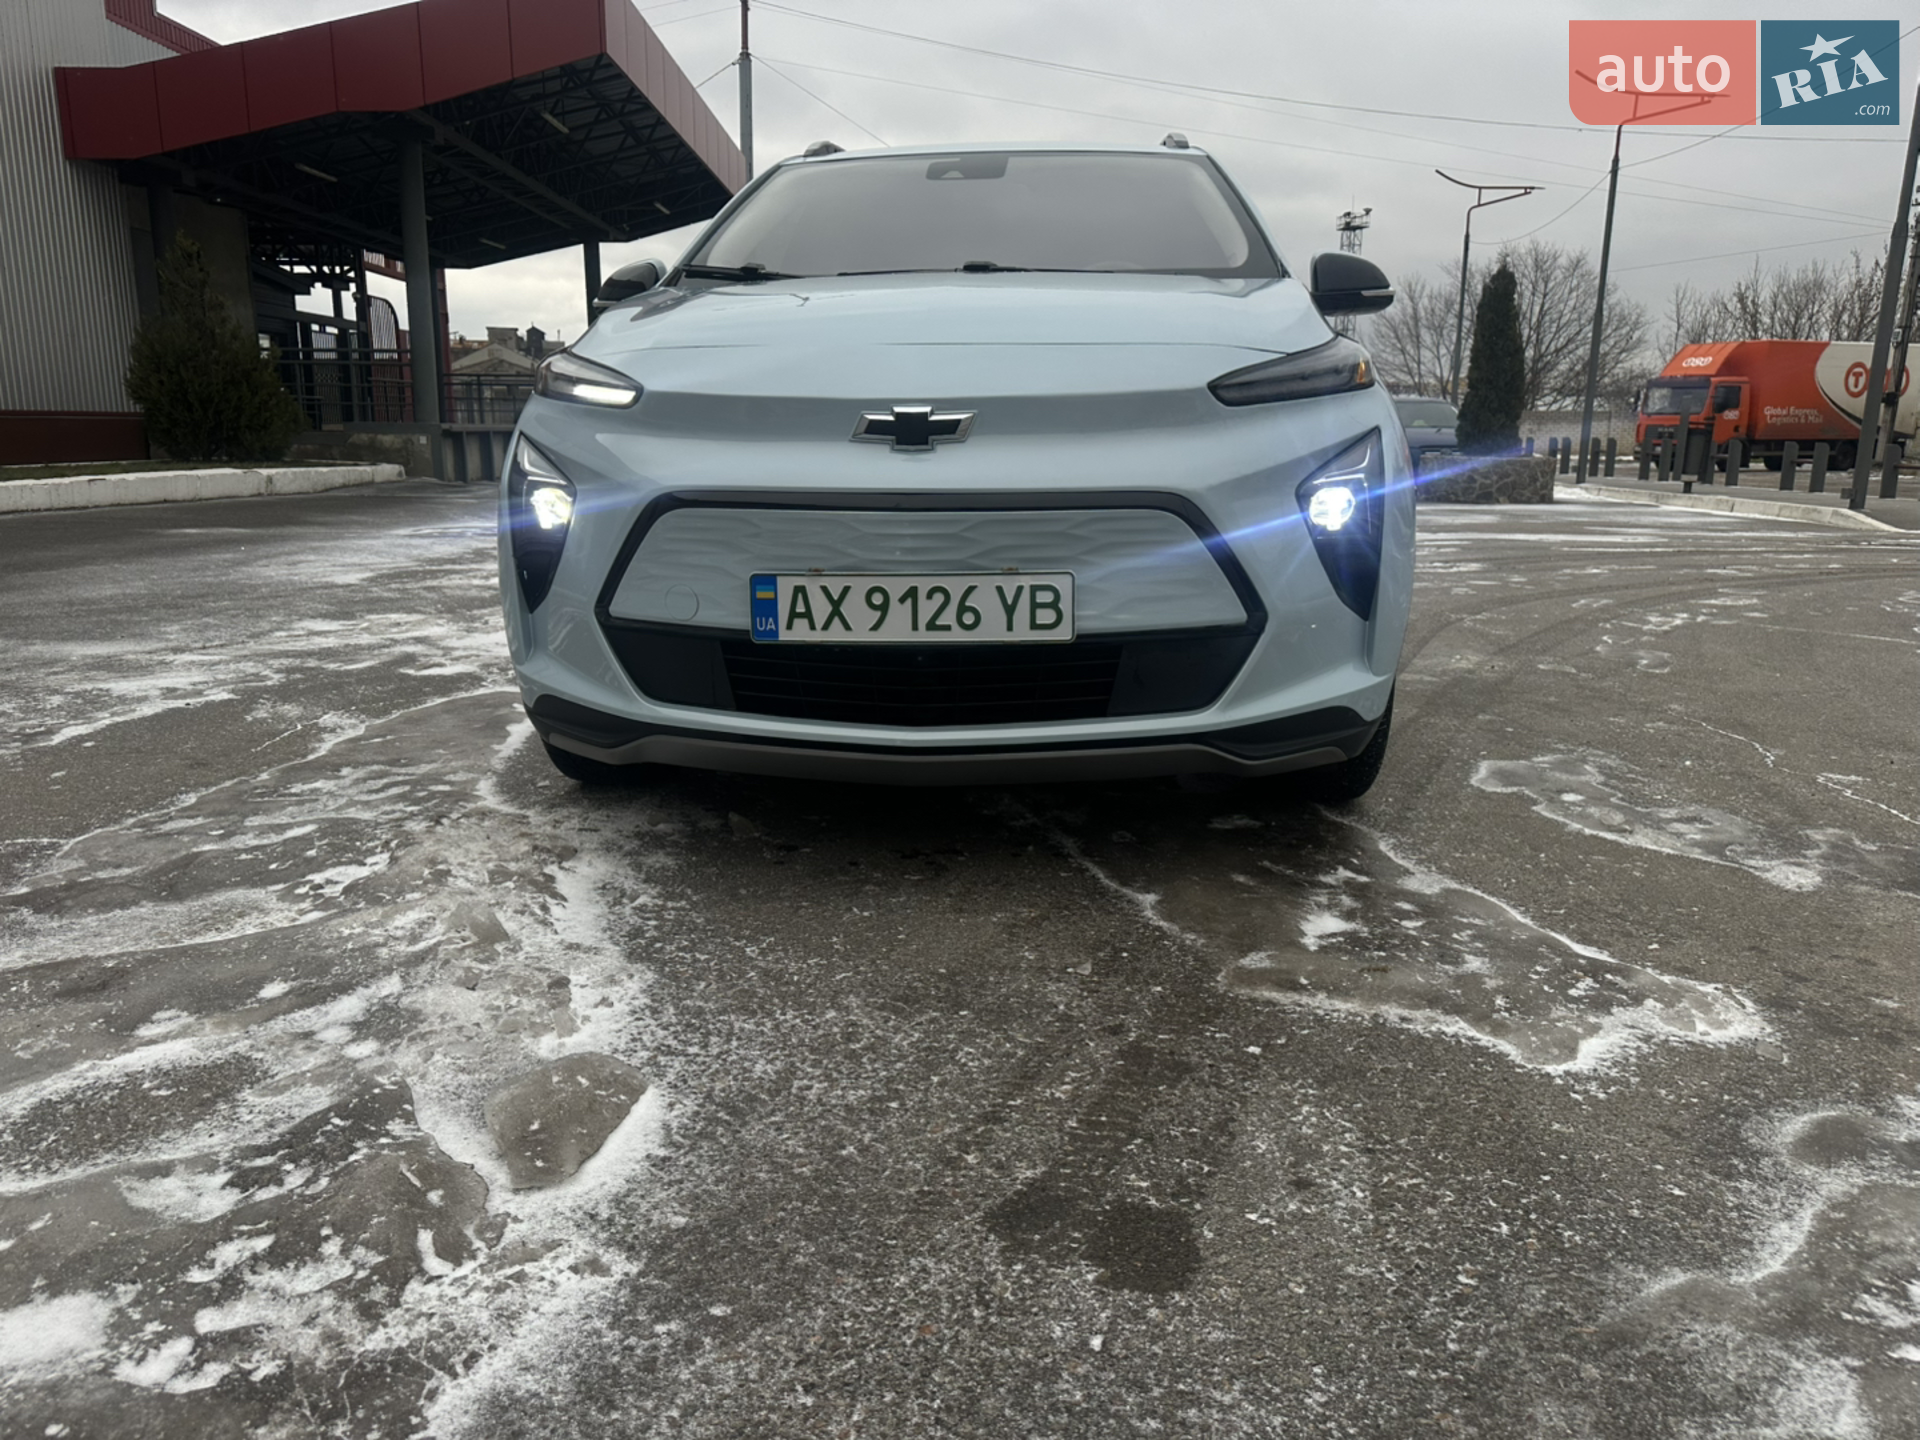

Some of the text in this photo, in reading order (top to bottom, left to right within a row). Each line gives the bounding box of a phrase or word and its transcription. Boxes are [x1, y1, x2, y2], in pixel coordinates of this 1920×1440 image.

[1763, 405, 1789, 415] Global
[785, 584, 1064, 632] AX 9126 YB
[756, 616, 776, 631] UA
